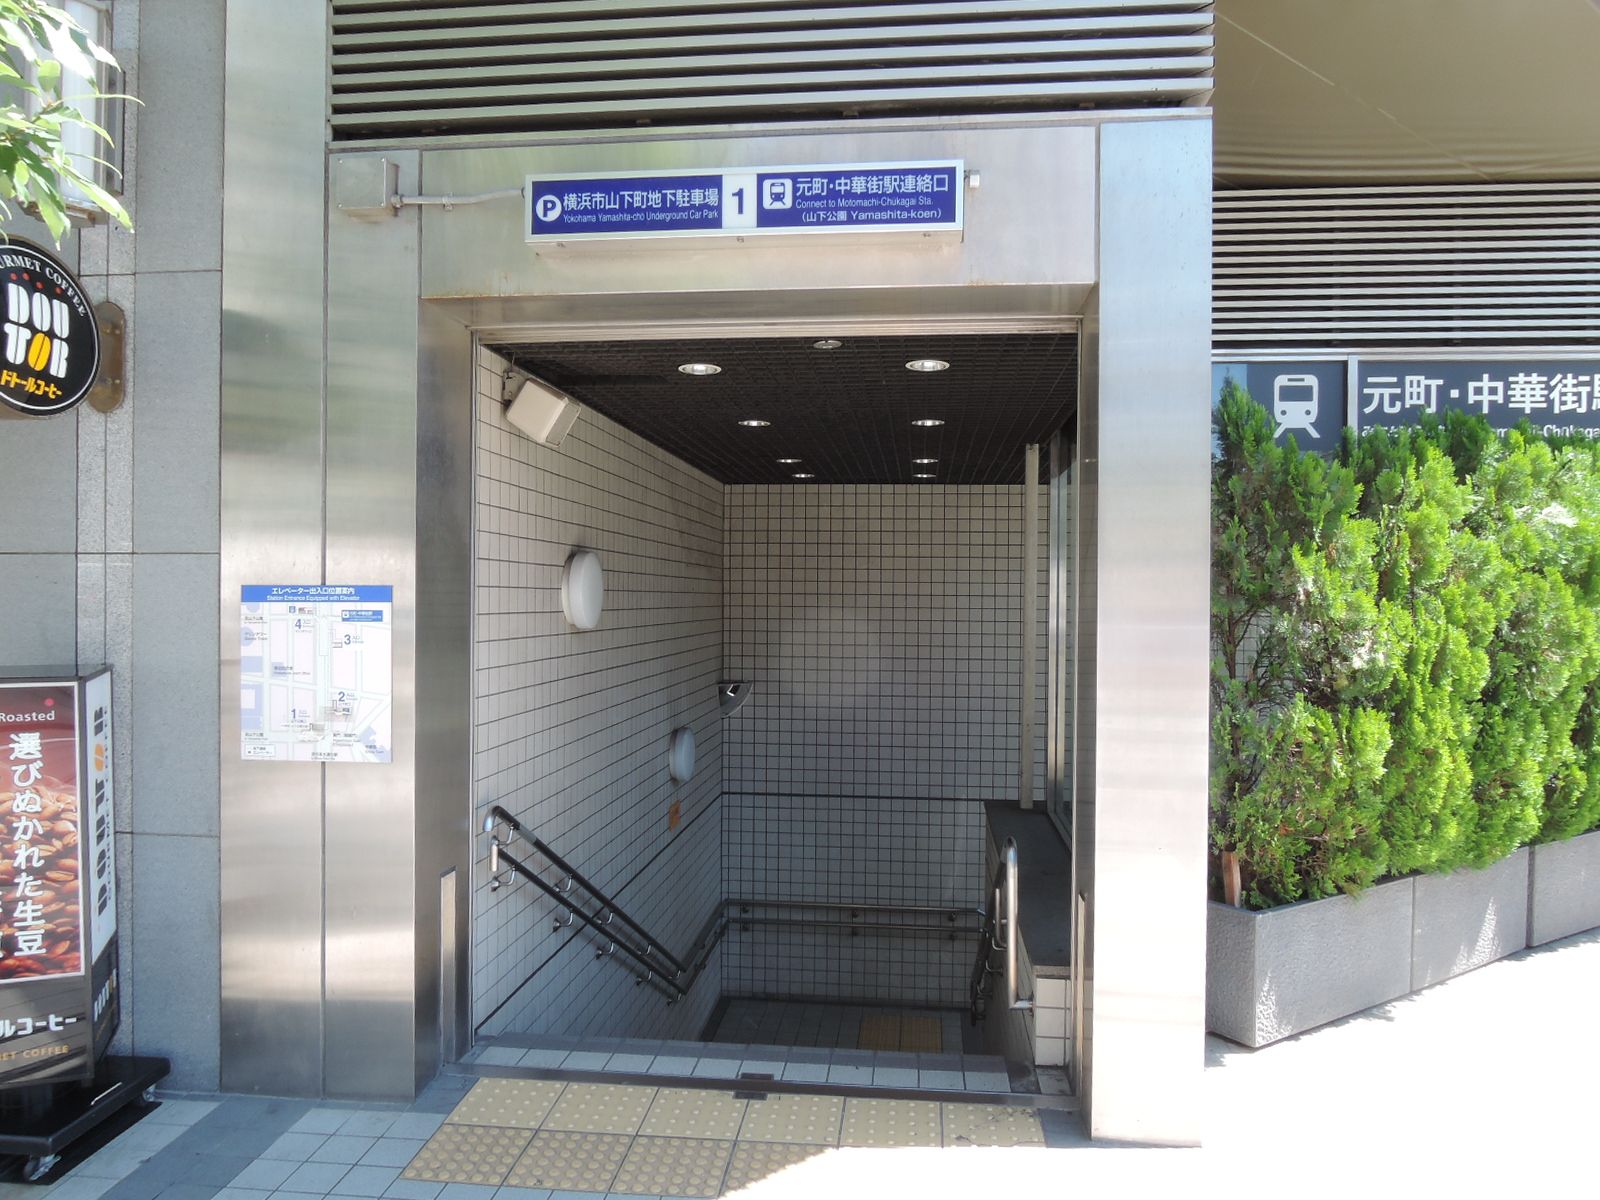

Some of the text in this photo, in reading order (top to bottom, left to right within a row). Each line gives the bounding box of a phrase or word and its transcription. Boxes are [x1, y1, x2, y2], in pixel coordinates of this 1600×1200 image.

[796, 174, 949, 197] 元町・中華街駅連絡口
[563, 188, 719, 211] 横浜市山下町地下駐車場
[732, 187, 744, 215] 1
[796, 196, 934, 209] Connect to Motomachi-Chukagai Sta.
[563, 209, 719, 224] Yokohama Yamashita-cho Underground Car Park
[45, 267, 87, 316] COFFEE
[1363, 373, 1600, 414] 元町・中華街
[294, 619, 302, 629] 4
[344, 634, 351, 645] 3
[338, 691, 345, 702] 2
[0, 710, 55, 722] Roasted
[291, 708, 296, 719] 1
[9, 732, 46, 958] 選びぬかれた生豆
[23, 1044, 69, 1058] COFFEE
